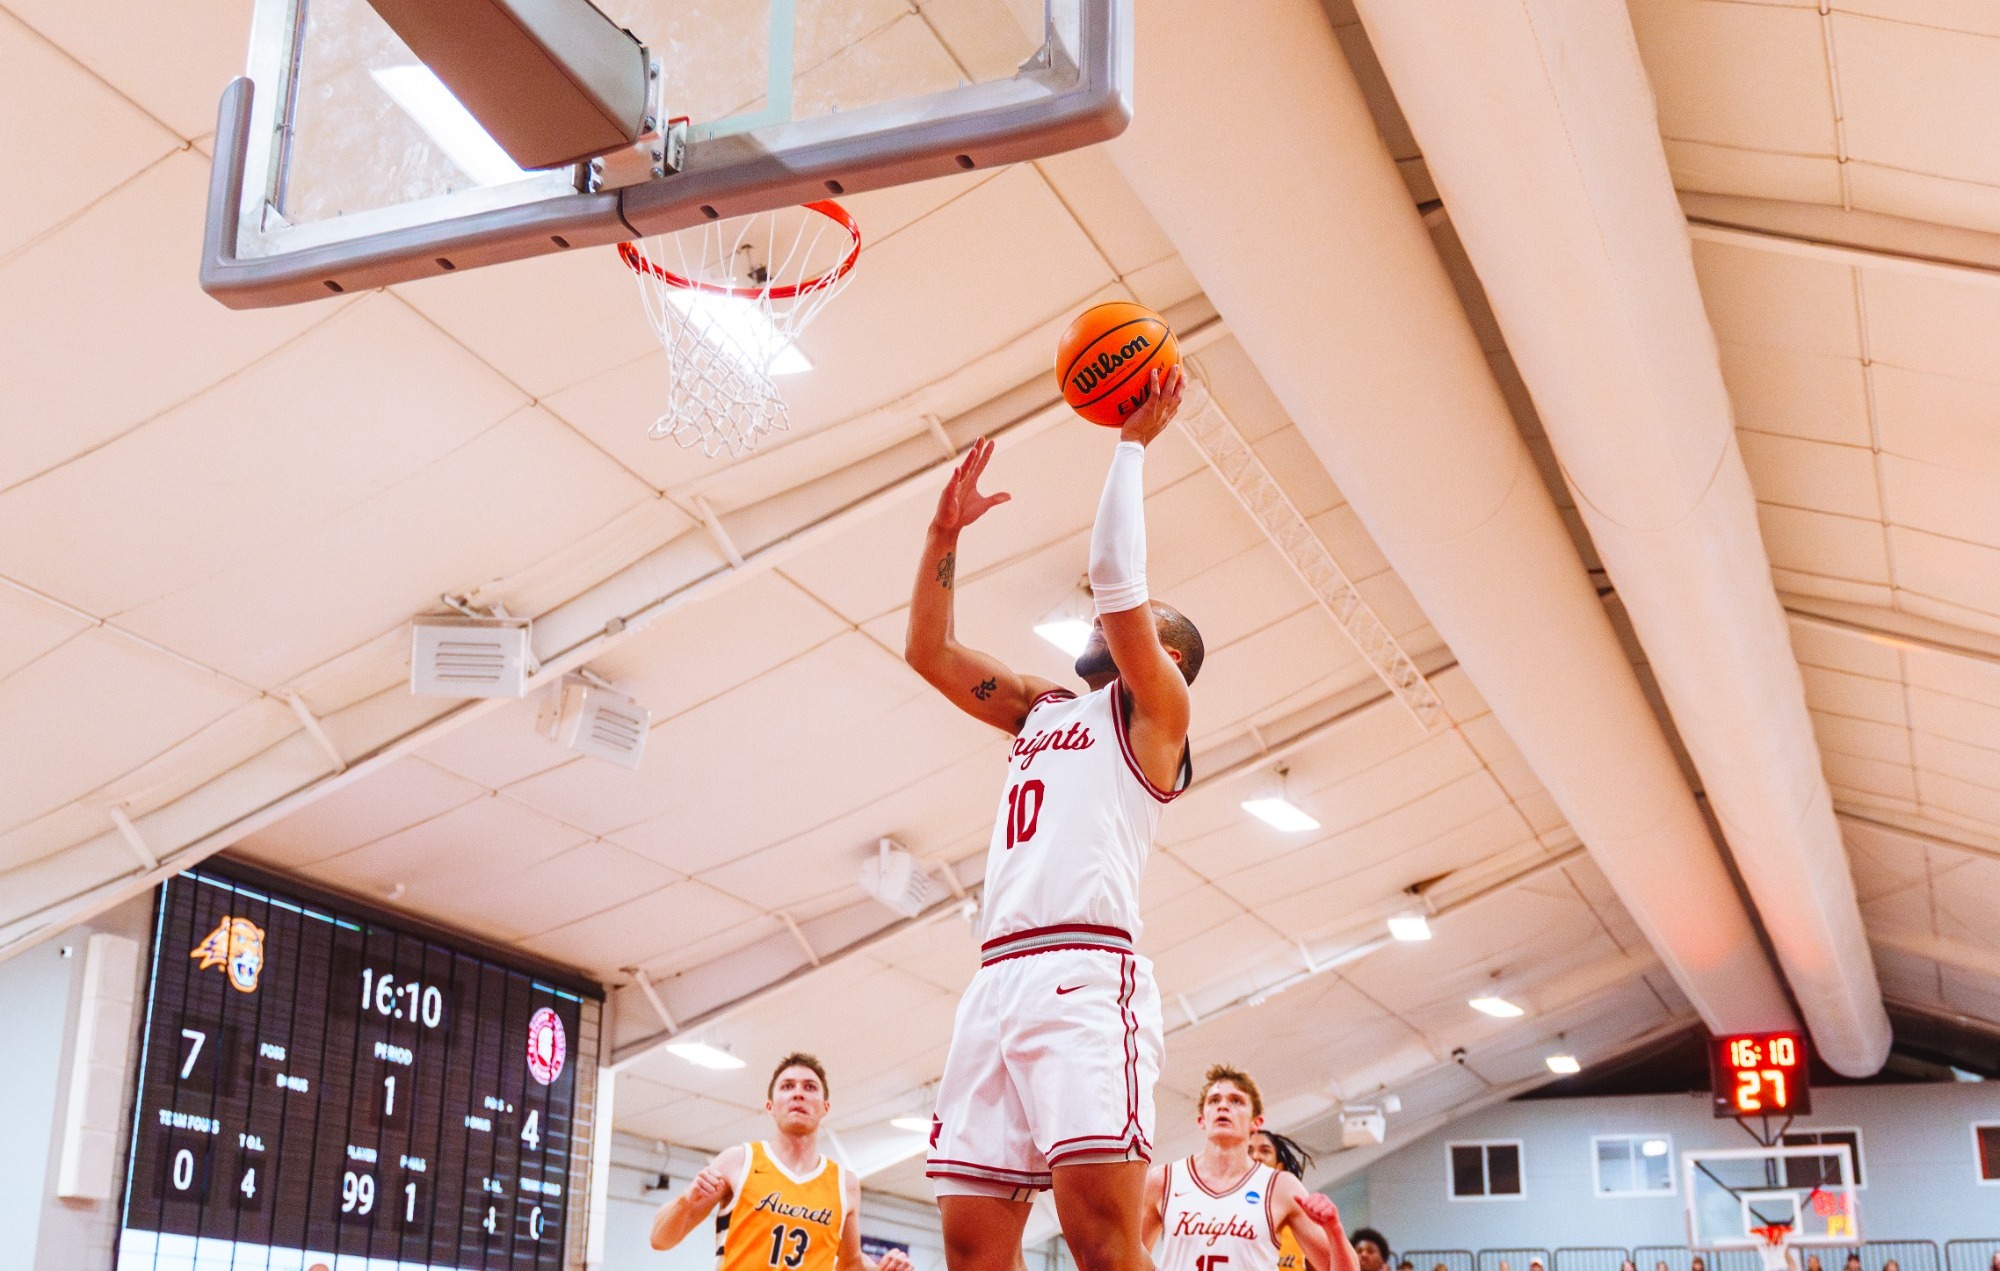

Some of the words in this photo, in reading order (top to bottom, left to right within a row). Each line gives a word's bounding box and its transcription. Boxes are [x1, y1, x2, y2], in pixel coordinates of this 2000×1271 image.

[1072, 335, 1151, 394] Wilson
[1008, 722, 1095, 770] nights
[1007, 779, 1045, 849] 10
[362, 968, 442, 1028] 16:10
[181, 1028, 206, 1079] 7
[374, 1041, 413, 1066] PERIOD
[1730, 1036, 1796, 1068] 16:10
[384, 1075, 396, 1116] 1
[1736, 1070, 1787, 1111] 27
[521, 1109, 540, 1151] 4
[173, 1149, 194, 1190] 0
[240, 1167, 256, 1198] 4
[342, 1171, 375, 1215] 99
[405, 1182, 416, 1223] 1
[755, 1191, 833, 1226] Averett
[769, 1224, 810, 1268] 13
[1173, 1211, 1258, 1247] Knights
